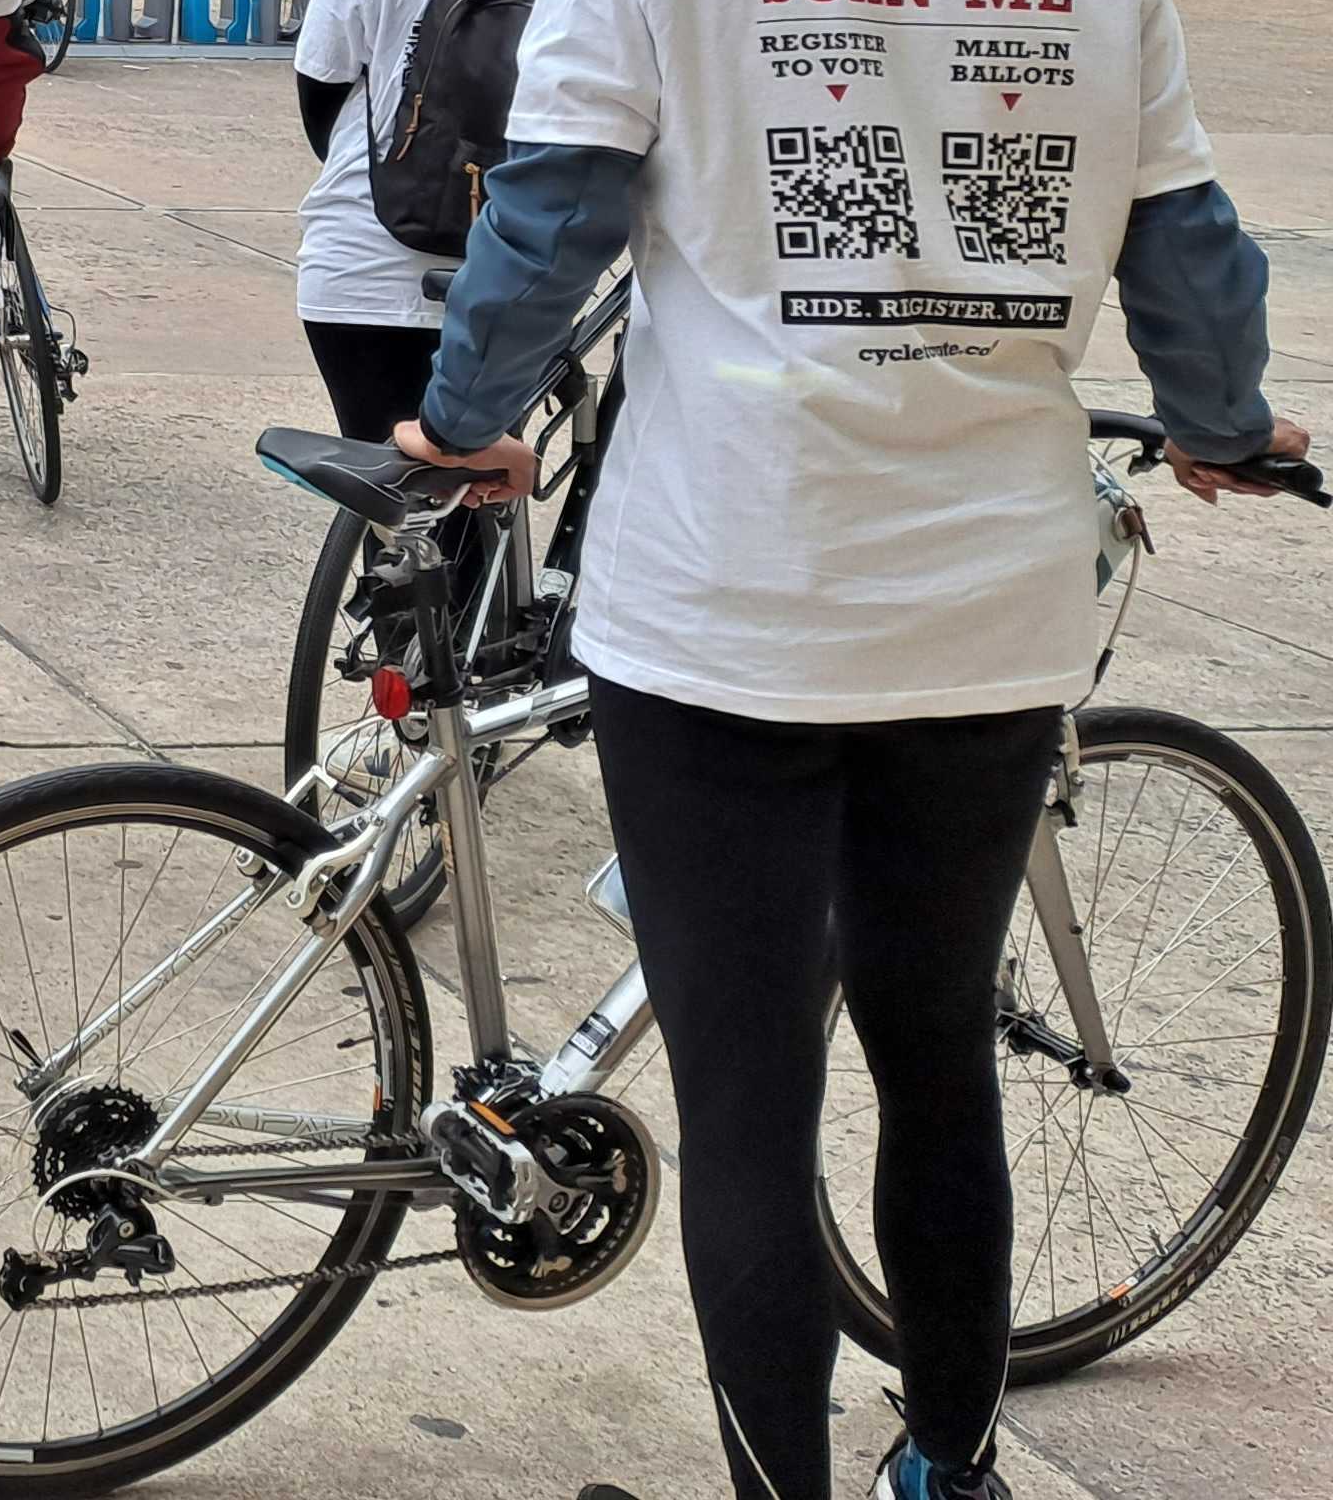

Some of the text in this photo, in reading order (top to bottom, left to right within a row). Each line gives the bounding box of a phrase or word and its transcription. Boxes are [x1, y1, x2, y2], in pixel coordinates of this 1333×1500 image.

[760, 32, 888, 54] REGISTER
[955, 39, 1071, 62] MAIL-IN
[772, 56, 885, 79] TO VOTE
[950, 64, 1076, 87] BALLOTS
[789, 297, 872, 319] RIDE.
[1008, 301, 1065, 323] VOTE.
